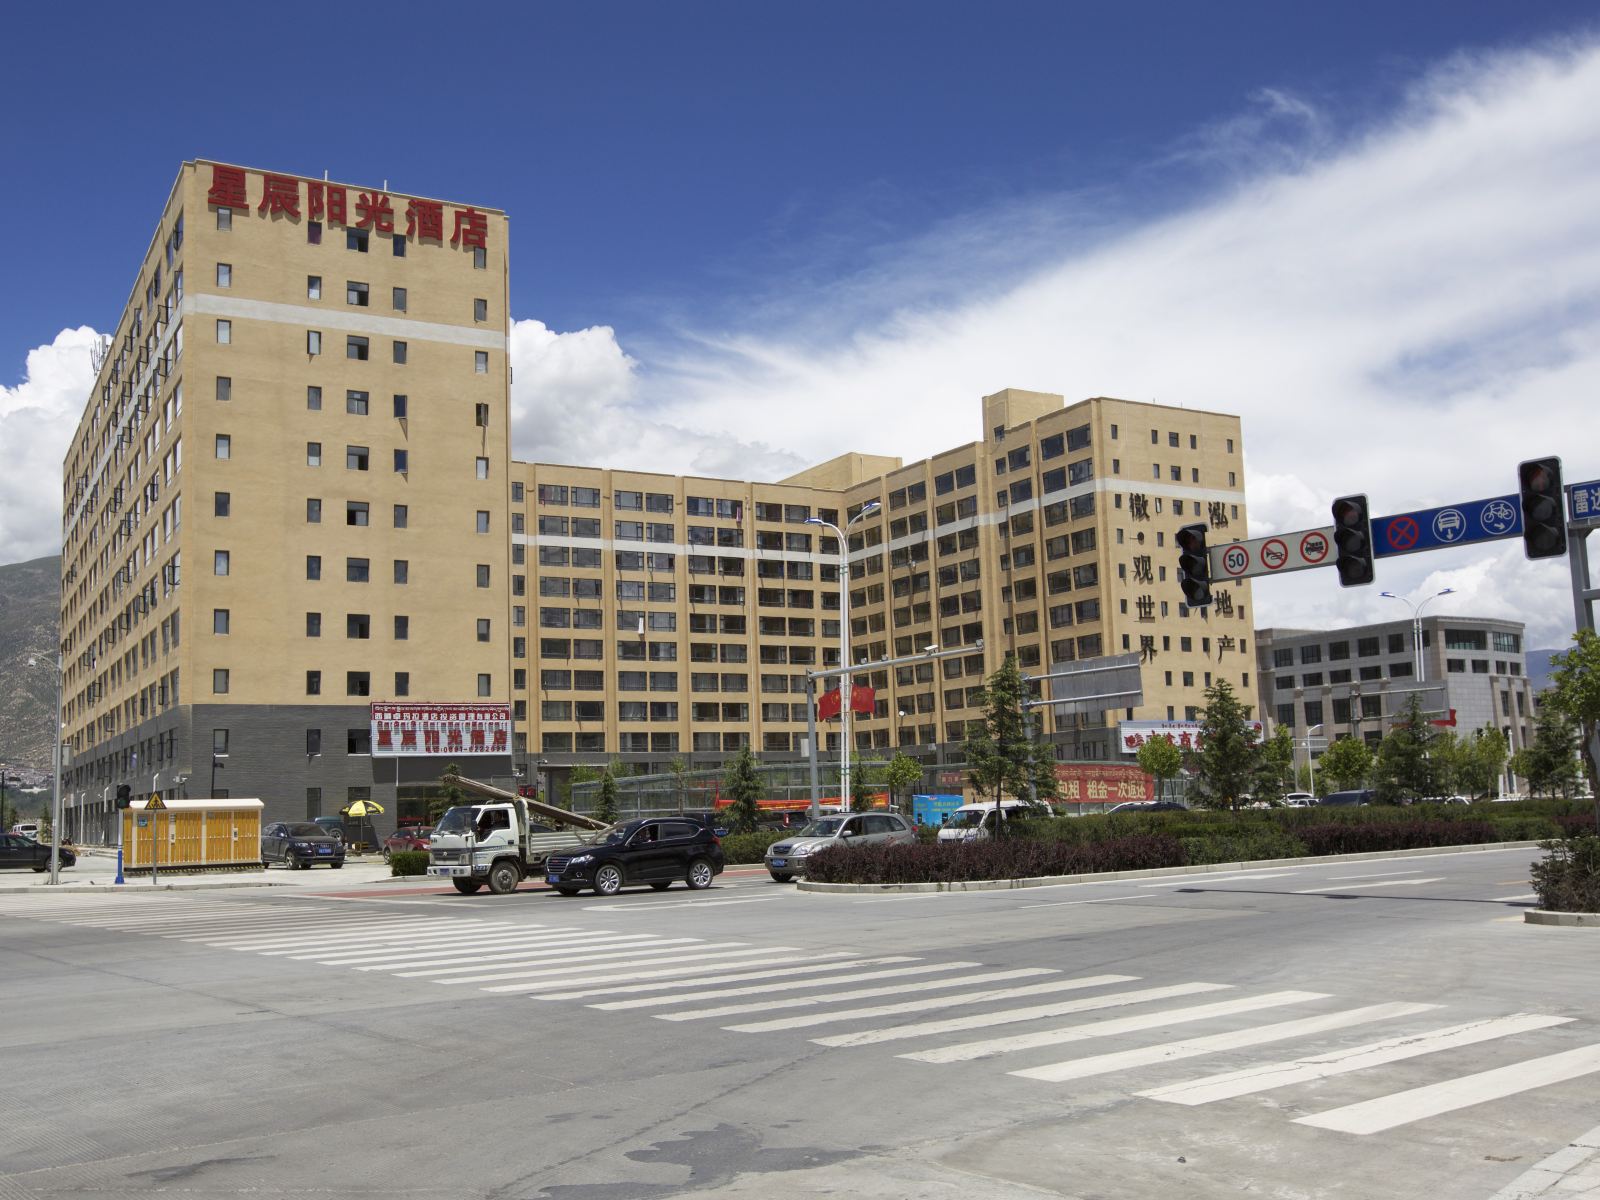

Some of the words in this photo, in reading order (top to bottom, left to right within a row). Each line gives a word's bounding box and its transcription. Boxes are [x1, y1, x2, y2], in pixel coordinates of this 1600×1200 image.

[208, 166, 488, 248] 星辰阳光酒店
[1228, 553, 1245, 569] 50
